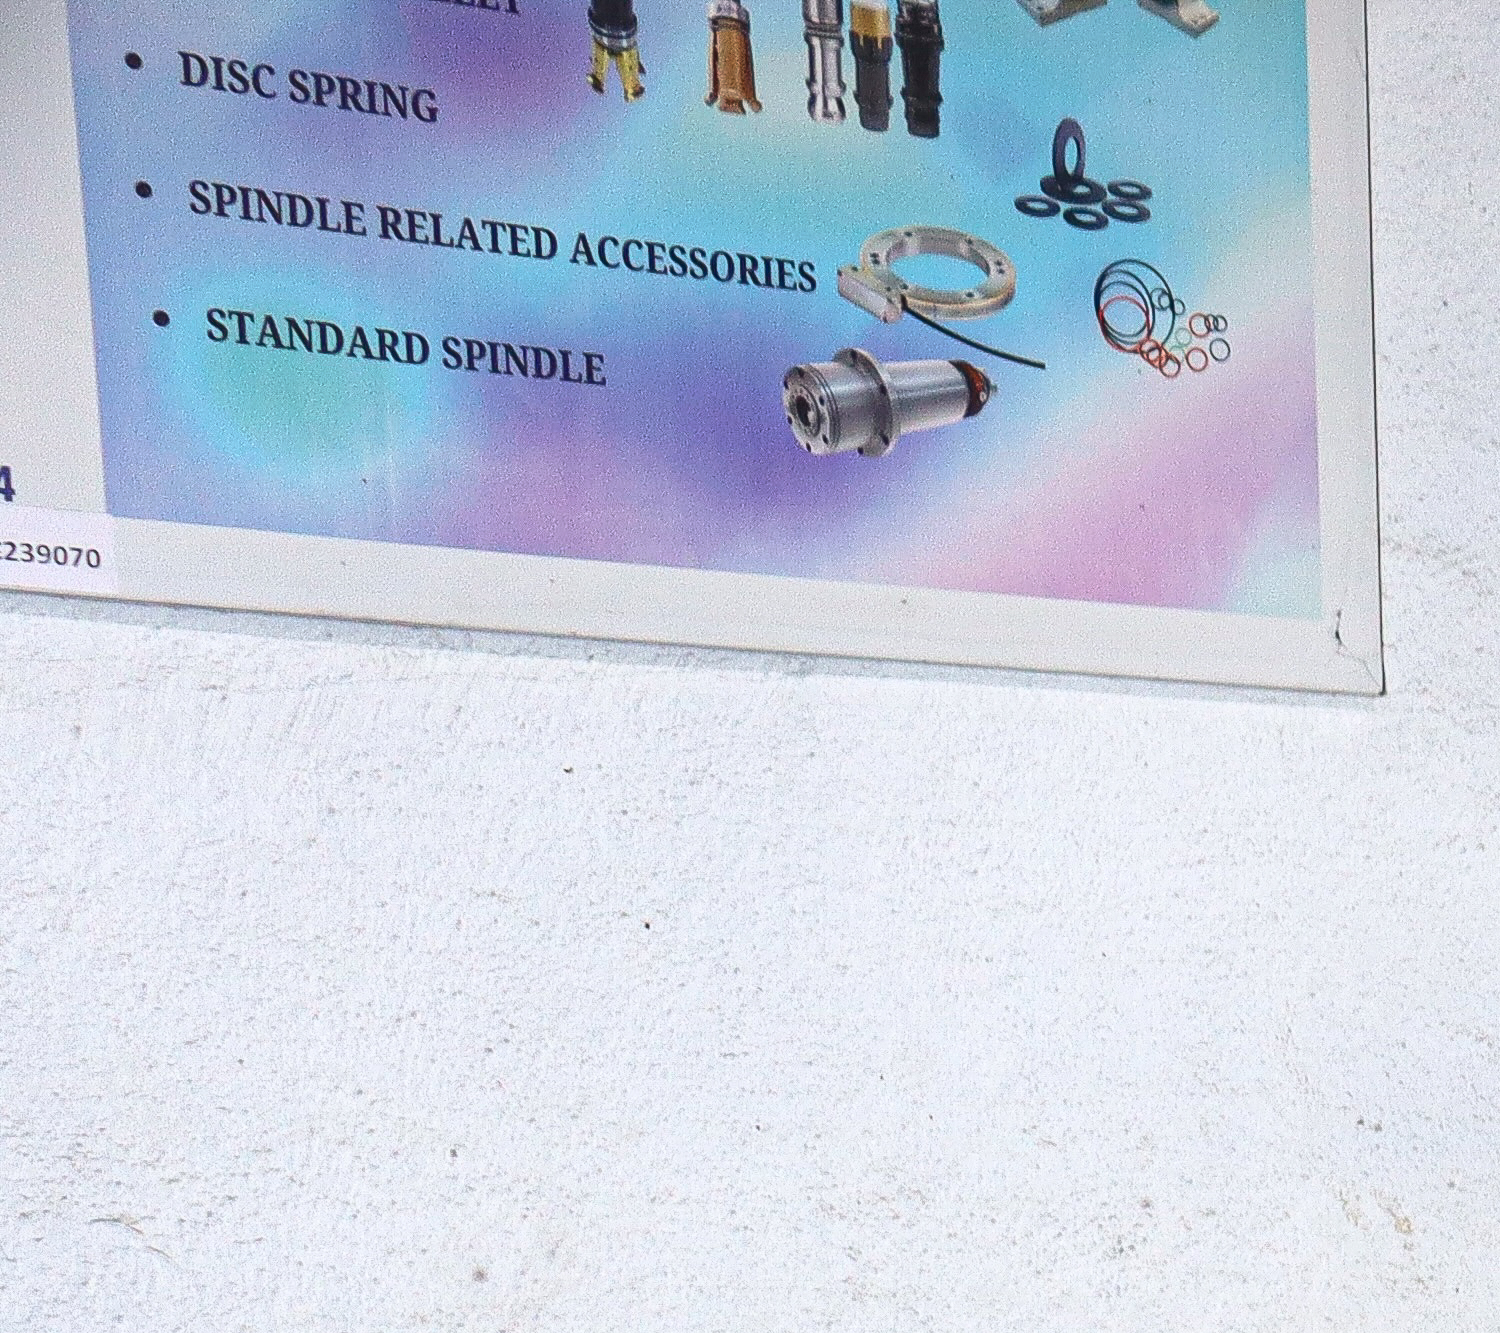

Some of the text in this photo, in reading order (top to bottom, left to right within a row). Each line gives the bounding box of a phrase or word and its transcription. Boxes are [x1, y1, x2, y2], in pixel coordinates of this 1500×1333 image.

[177, 50, 439, 122] DISC SPRING
[188, 179, 818, 293] SPINDLE RELATED ACCESSORIES
[206, 308, 608, 386] STANDARD SPINDLE
[0, 541, 101, 568] 239070
